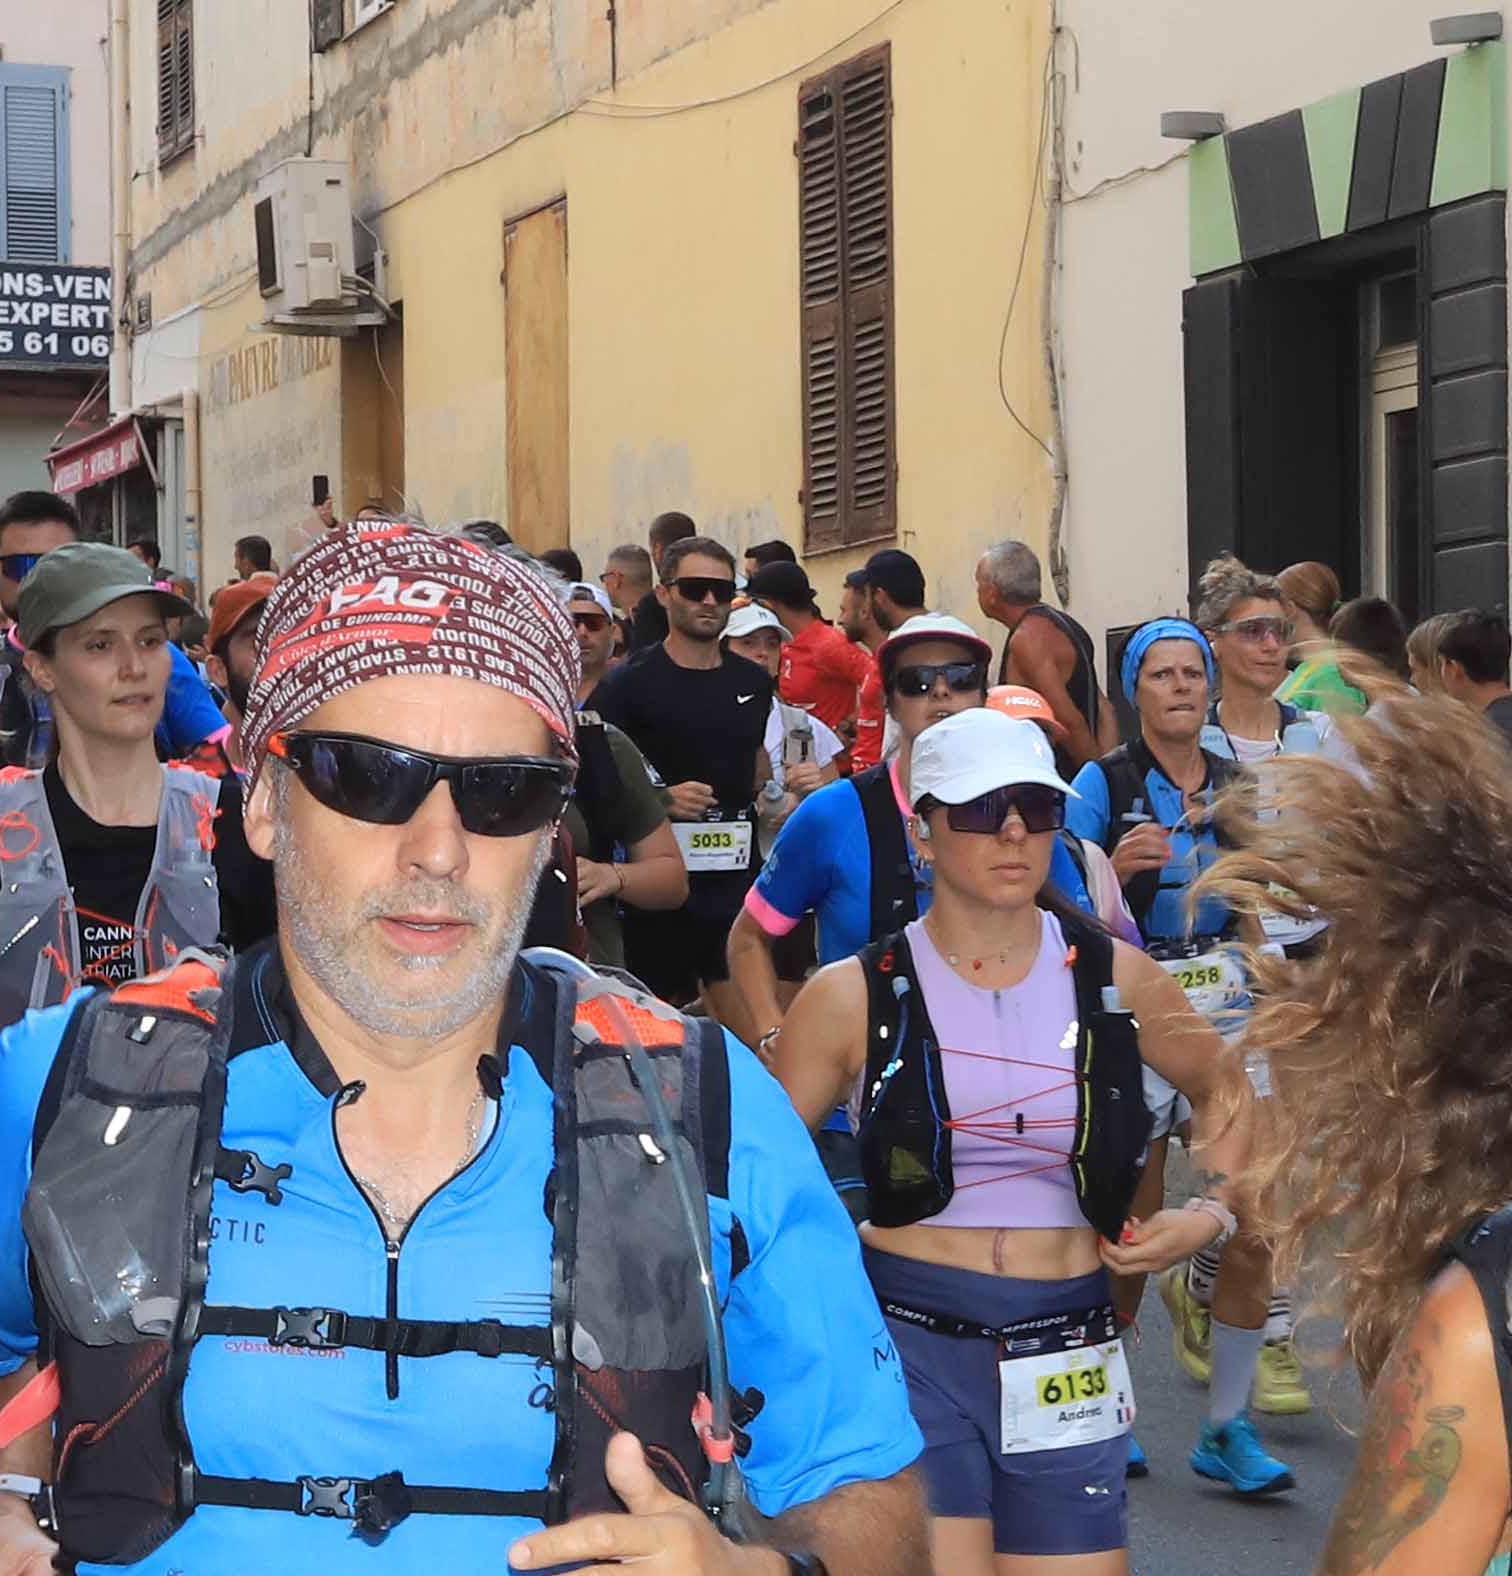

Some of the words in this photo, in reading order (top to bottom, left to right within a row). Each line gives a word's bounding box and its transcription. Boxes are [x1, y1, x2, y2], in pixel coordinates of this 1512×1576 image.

[23, 331, 59, 355] 61
[71, 334, 110, 358] 06
[349, 649, 406, 672] STADE
[427, 645, 480, 664] 1912
[691, 833, 732, 849] 5033
[84, 927, 132, 941] CANN
[1176, 967, 1219, 988] 258
[210, 1217, 265, 1245] CTIC
[1043, 1367, 1106, 1404] 6133
